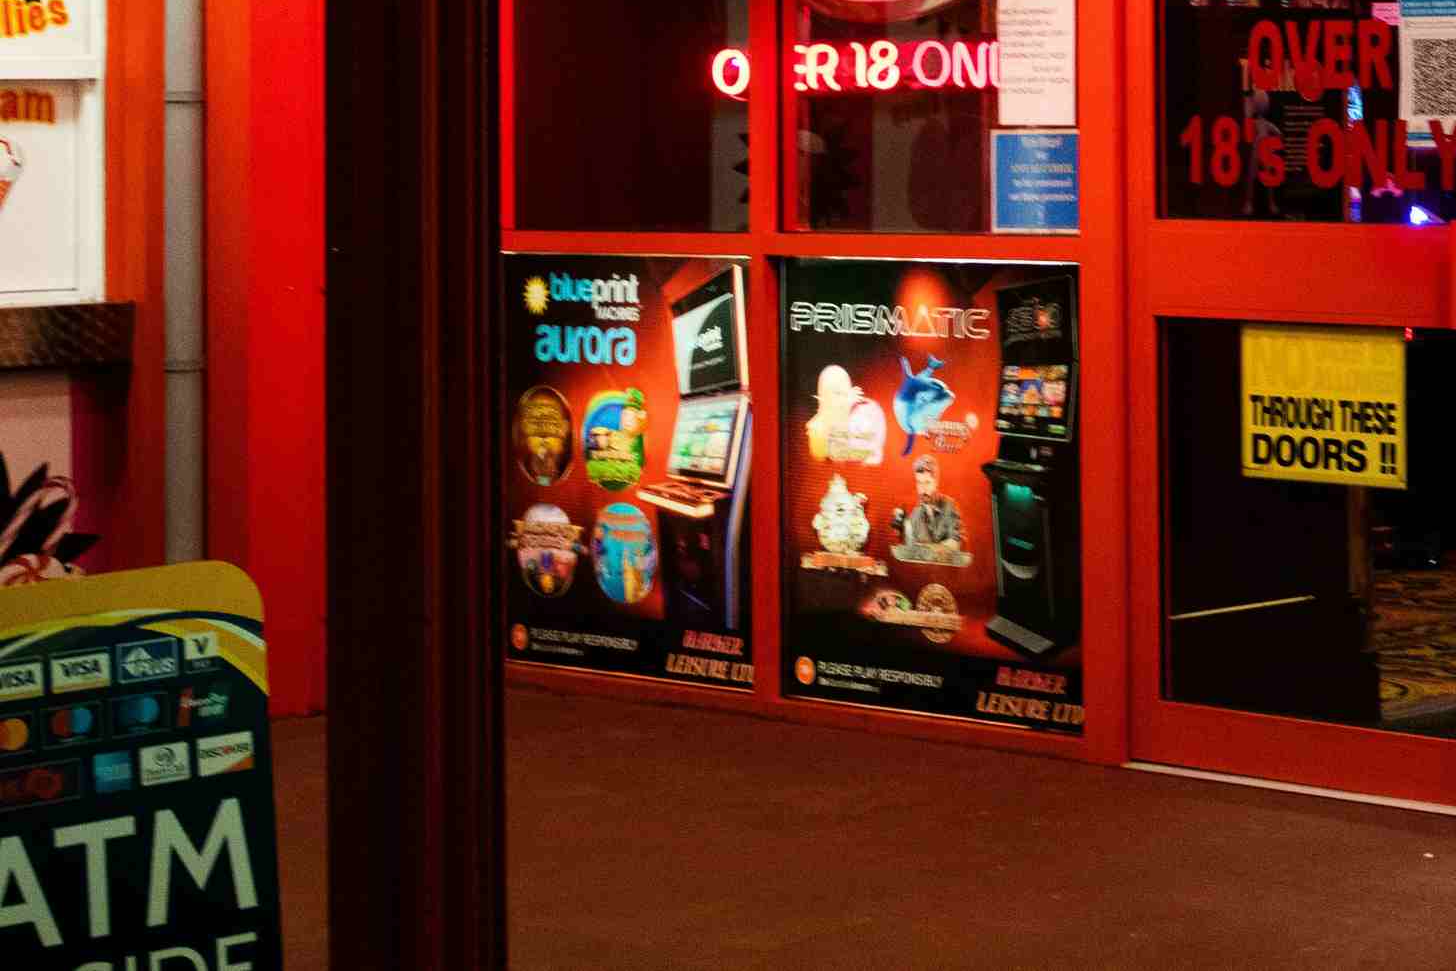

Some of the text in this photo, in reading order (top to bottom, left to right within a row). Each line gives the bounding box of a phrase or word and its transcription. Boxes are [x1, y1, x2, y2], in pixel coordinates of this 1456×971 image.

[852, 40, 900, 90] 18
[1249, 19, 1394, 92] OVER
[1180, 115, 1287, 189] 18's
[550, 271, 640, 309] blueprint
[790, 300, 991, 340] PRISMATIC
[534, 323, 637, 367] aurora
[1250, 393, 1397, 436] THROUGH THESE
[1252, 432, 1368, 473] DOORS
[0, 797, 259, 948] ATM
